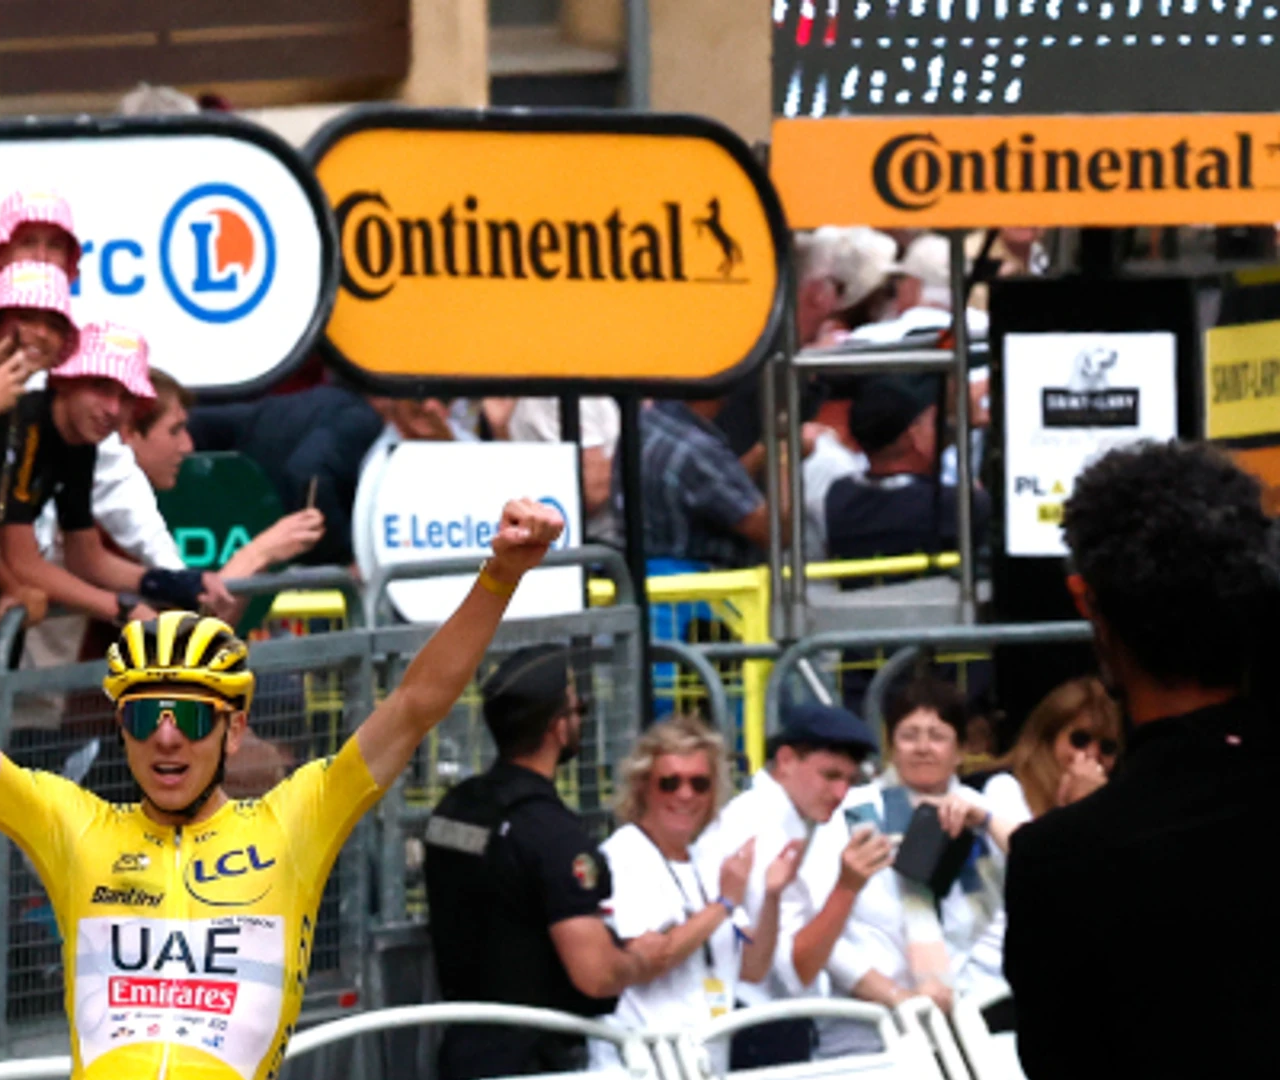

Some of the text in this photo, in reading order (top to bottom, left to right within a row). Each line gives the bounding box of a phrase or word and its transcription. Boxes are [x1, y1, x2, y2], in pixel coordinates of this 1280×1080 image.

[871, 131, 1253, 212] Continental
[334, 190, 688, 301] Continental
[383, 512, 502, 549] E.Lecle
[193, 845, 276, 884] LCL
[111, 924, 242, 974] UAE
[111, 979, 235, 1010] Emirates
